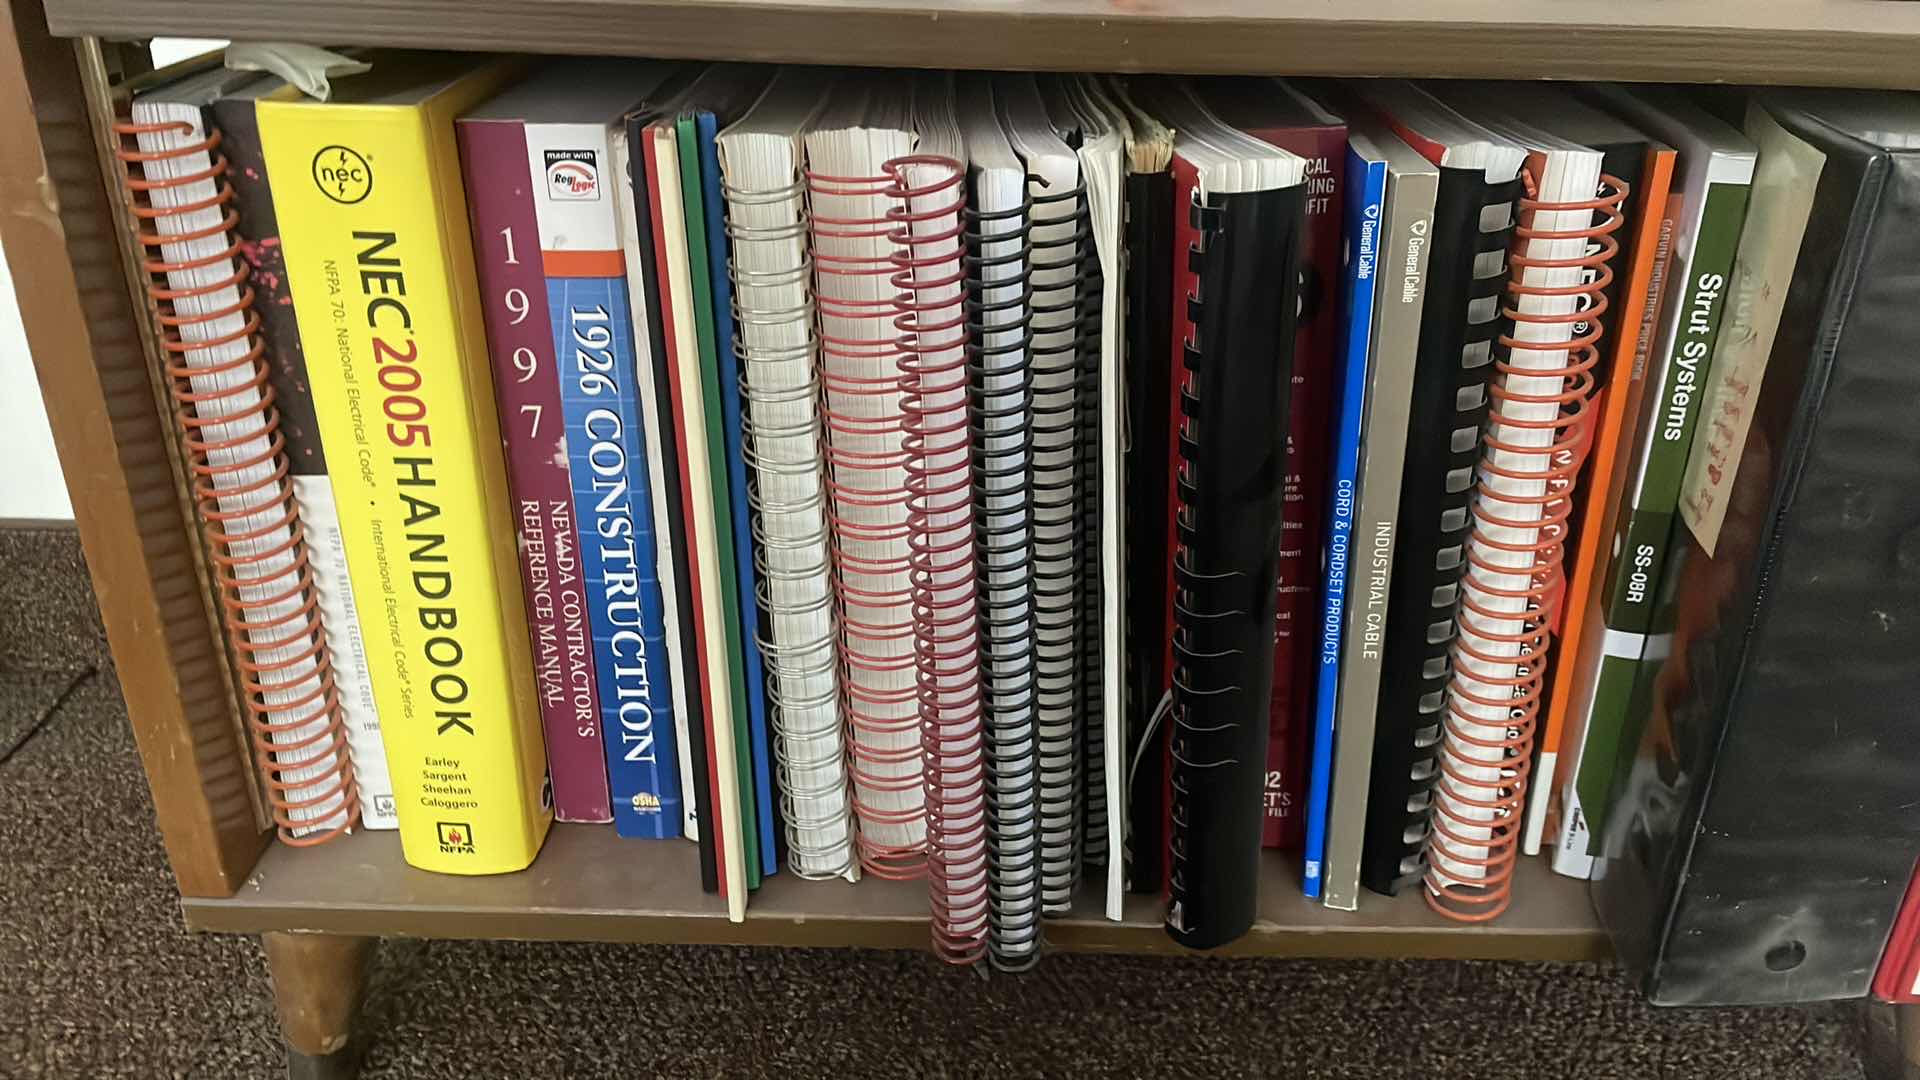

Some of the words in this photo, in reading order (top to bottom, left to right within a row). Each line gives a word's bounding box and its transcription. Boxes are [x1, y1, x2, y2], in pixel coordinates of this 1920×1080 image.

[321, 166, 363, 183] nec
[546, 151, 572, 160] made
[573, 151, 594, 160] with
[1360, 220, 1377, 254] General
[1405, 237, 1425, 275] General
[323, 259, 341, 296] NFPA
[351, 230, 412, 331] NEC
[1358, 254, 1374, 280] Cable
[1402, 275, 1421, 303] Cable
[1687, 273, 1723, 335] Strut
[336, 327, 359, 385] National
[570, 304, 619, 396] 1926
[346, 388, 369, 446] Electrical
[371, 336, 432, 447] 2005
[1663, 341, 1708, 442] Systems
[1334, 520, 1348, 530] &
[1335, 479, 1352, 517] CORD
[521, 499, 554, 620] REFERENCE
[549, 499, 577, 586] NEVADA
[1328, 534, 1347, 594] CORDSET
[1368, 520, 1392, 609] INDUSTRIAL
[392, 456, 475, 736] HANDBOOK
[584, 408, 657, 765] CONSTRUCTION
[1625, 544, 1655, 603] SS-08R
[370, 519, 396, 594] International
[384, 597, 405, 648] Electrical
[399, 686, 415, 720] Series
[1322, 598, 1341, 665] PRODUCTS
[1362, 613, 1382, 660] CABLE
[537, 623, 565, 709] MANUAL
[561, 590, 595, 738] CONTRACTOR'S
[422, 770, 467, 783] Sargent
[422, 783, 472, 796] Sheehan
[424, 757, 460, 770] Earley
[420, 797, 478, 810] Caloggero
[440, 845, 476, 855] NFPA
